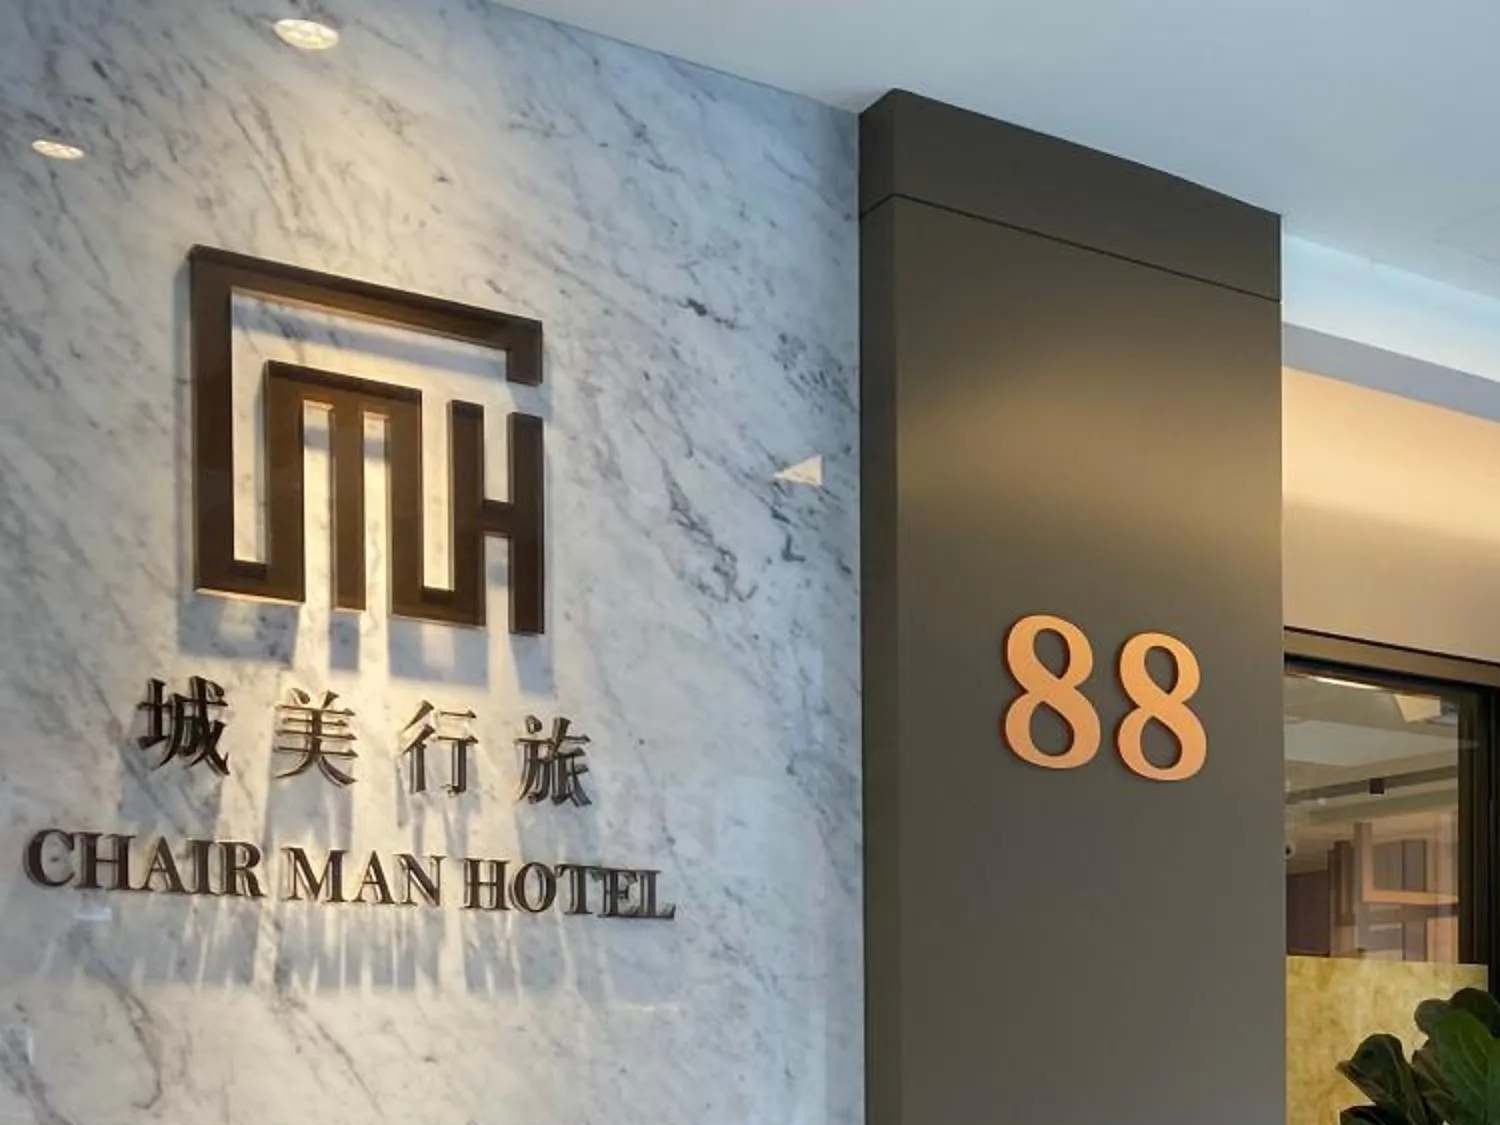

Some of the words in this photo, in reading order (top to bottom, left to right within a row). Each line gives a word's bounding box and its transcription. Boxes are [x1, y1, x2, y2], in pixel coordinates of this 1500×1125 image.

[137, 675, 592, 807] 城美行旅
[1003, 613, 1208, 782] 88
[24, 828, 266, 898] CHAIR
[281, 846, 446, 906] MAN
[461, 856, 677, 919] HOTEL
